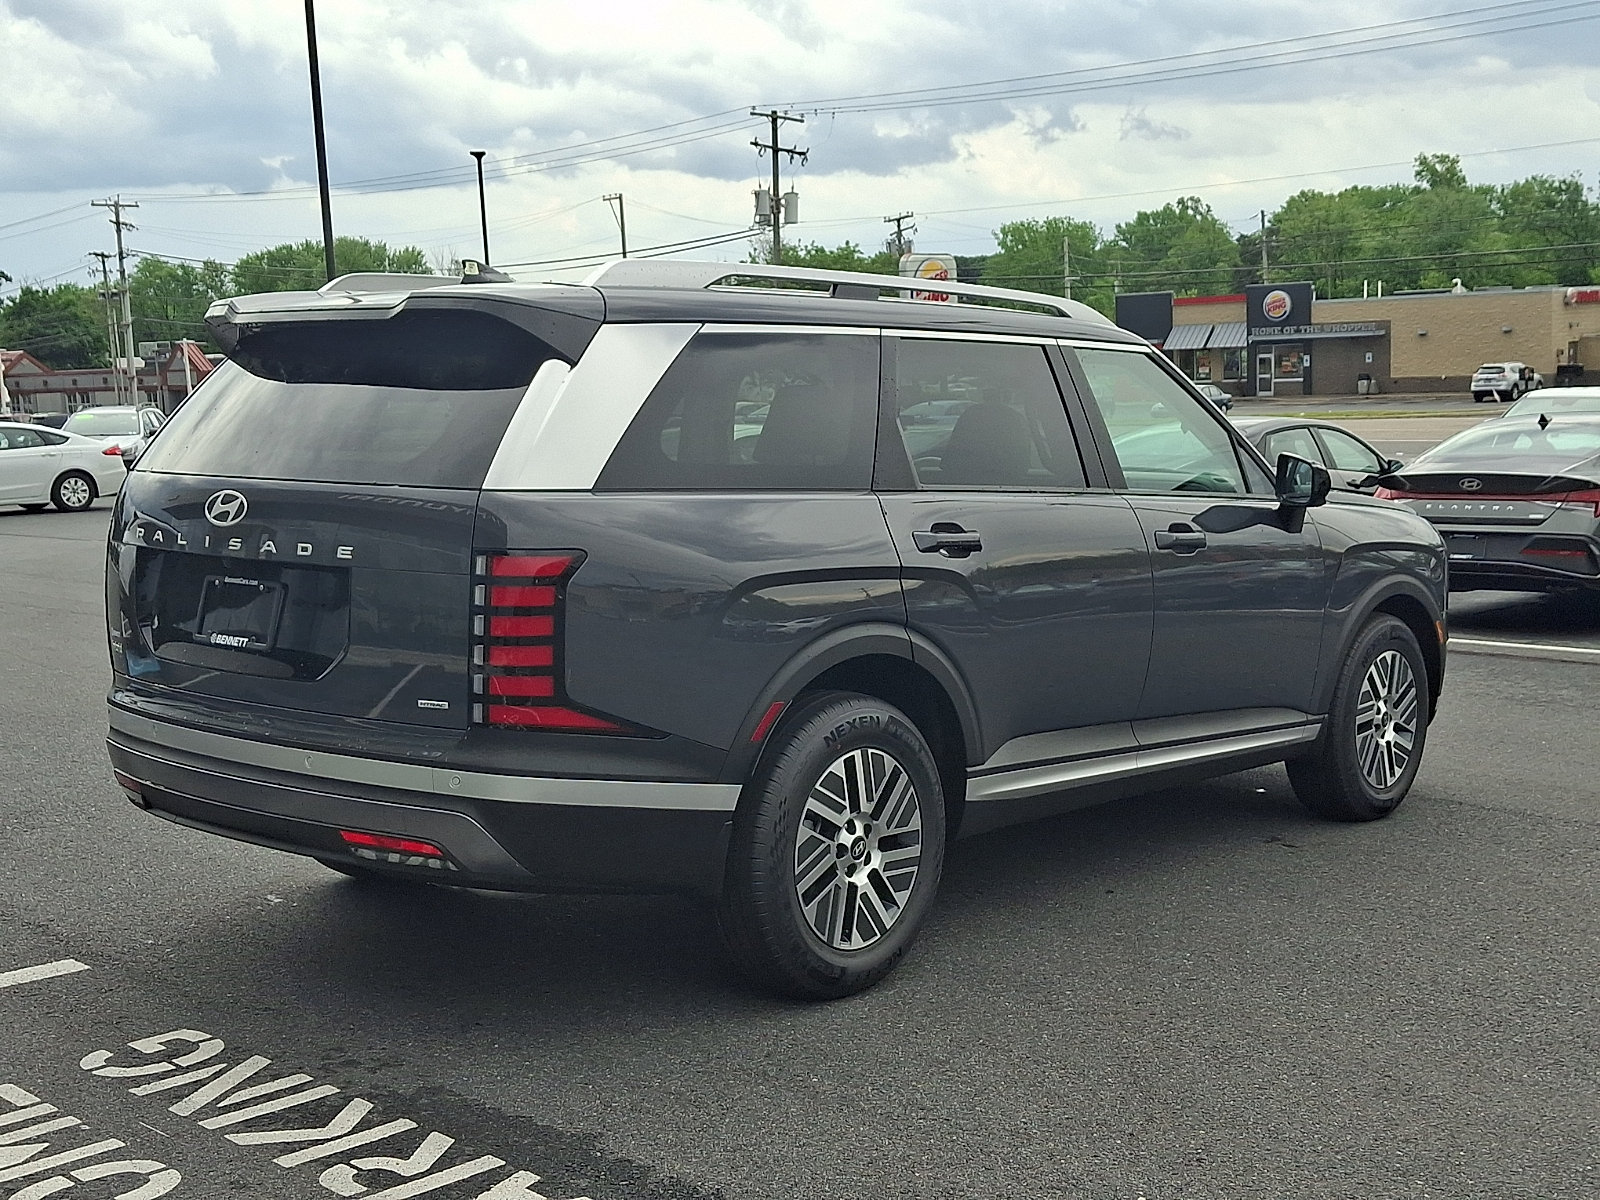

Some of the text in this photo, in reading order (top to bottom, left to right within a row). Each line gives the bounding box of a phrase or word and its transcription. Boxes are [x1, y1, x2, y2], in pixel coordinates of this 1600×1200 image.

[1251, 322, 1376, 336] HOME OF THE WHOPPER
[1425, 503, 1514, 511] ELANTRA
[136, 526, 354, 559] PALISADE
[216, 634, 249, 648] BENNETT
[823, 715, 881, 748] NEXEN
[79, 1029, 600, 1200] RKING
